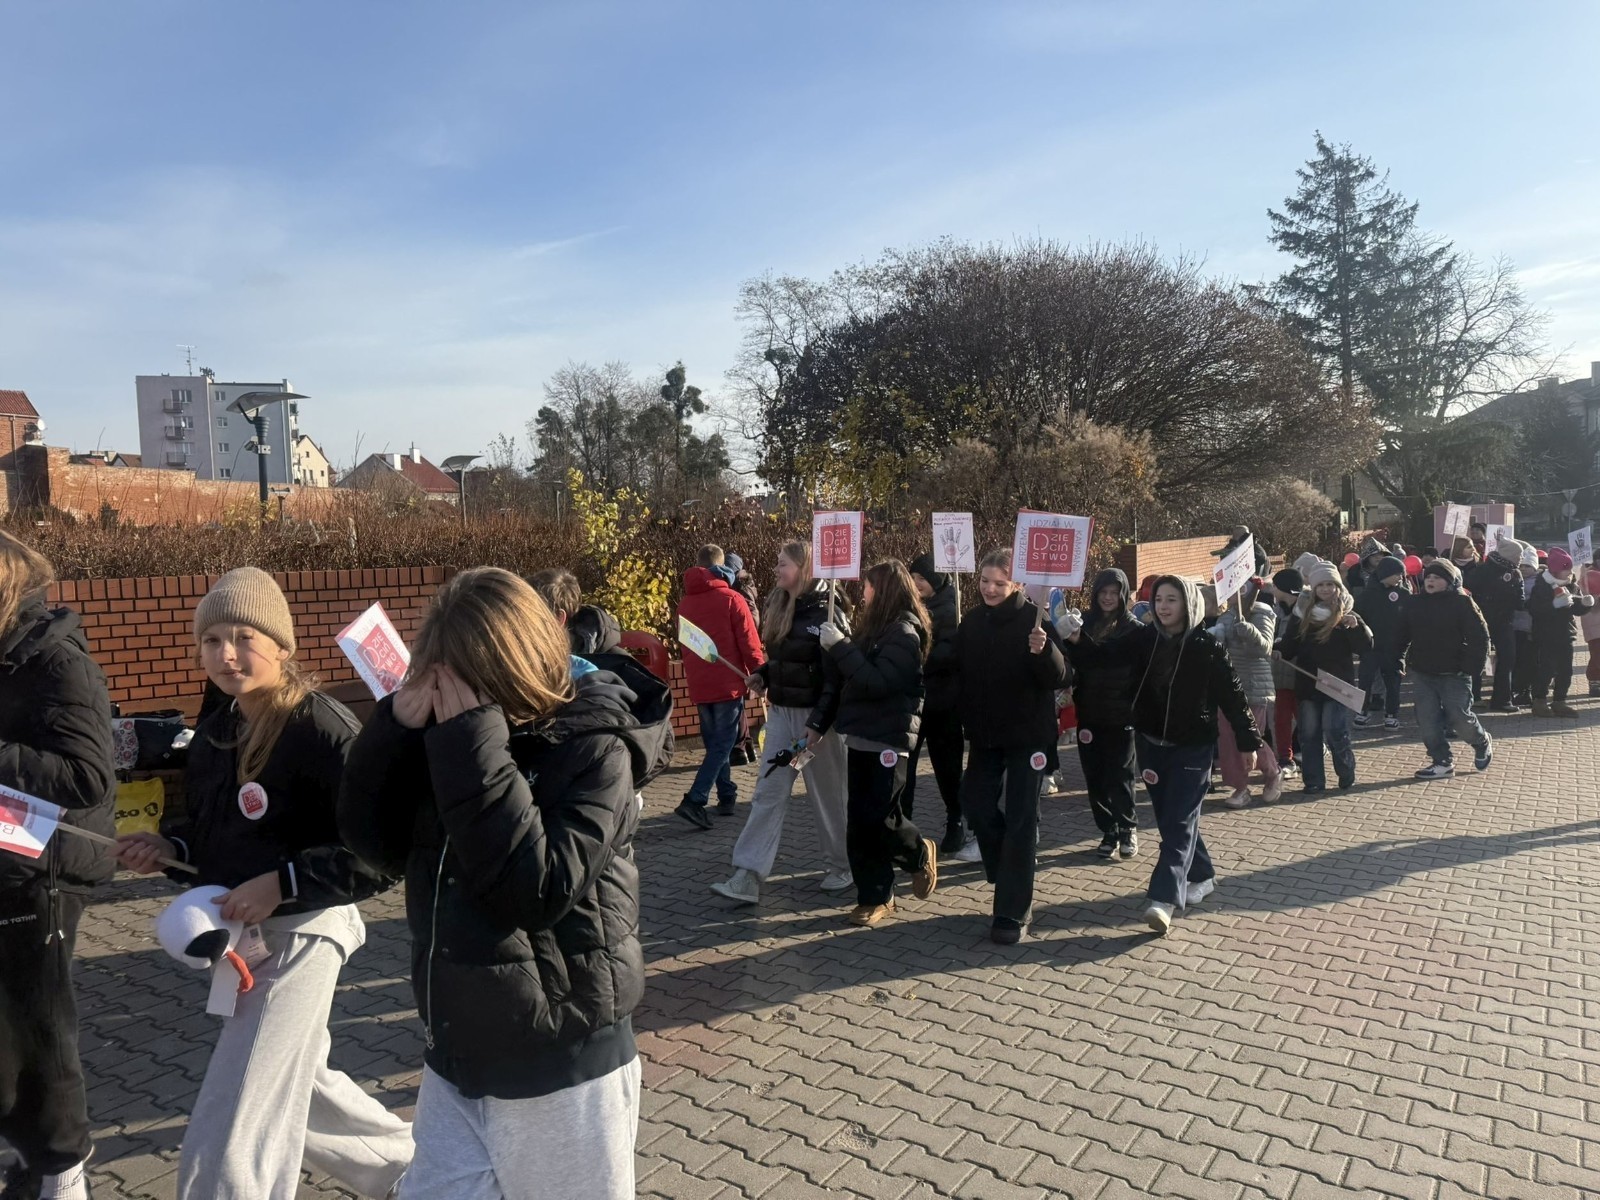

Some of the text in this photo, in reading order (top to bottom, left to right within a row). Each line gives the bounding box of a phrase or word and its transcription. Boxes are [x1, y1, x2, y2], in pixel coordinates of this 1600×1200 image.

[1064, 520, 1074, 528] W
[823, 547, 848, 555] STWO
[1017, 526, 1028, 570] BIERZEMY
[1032, 552, 1068, 561] STWO
